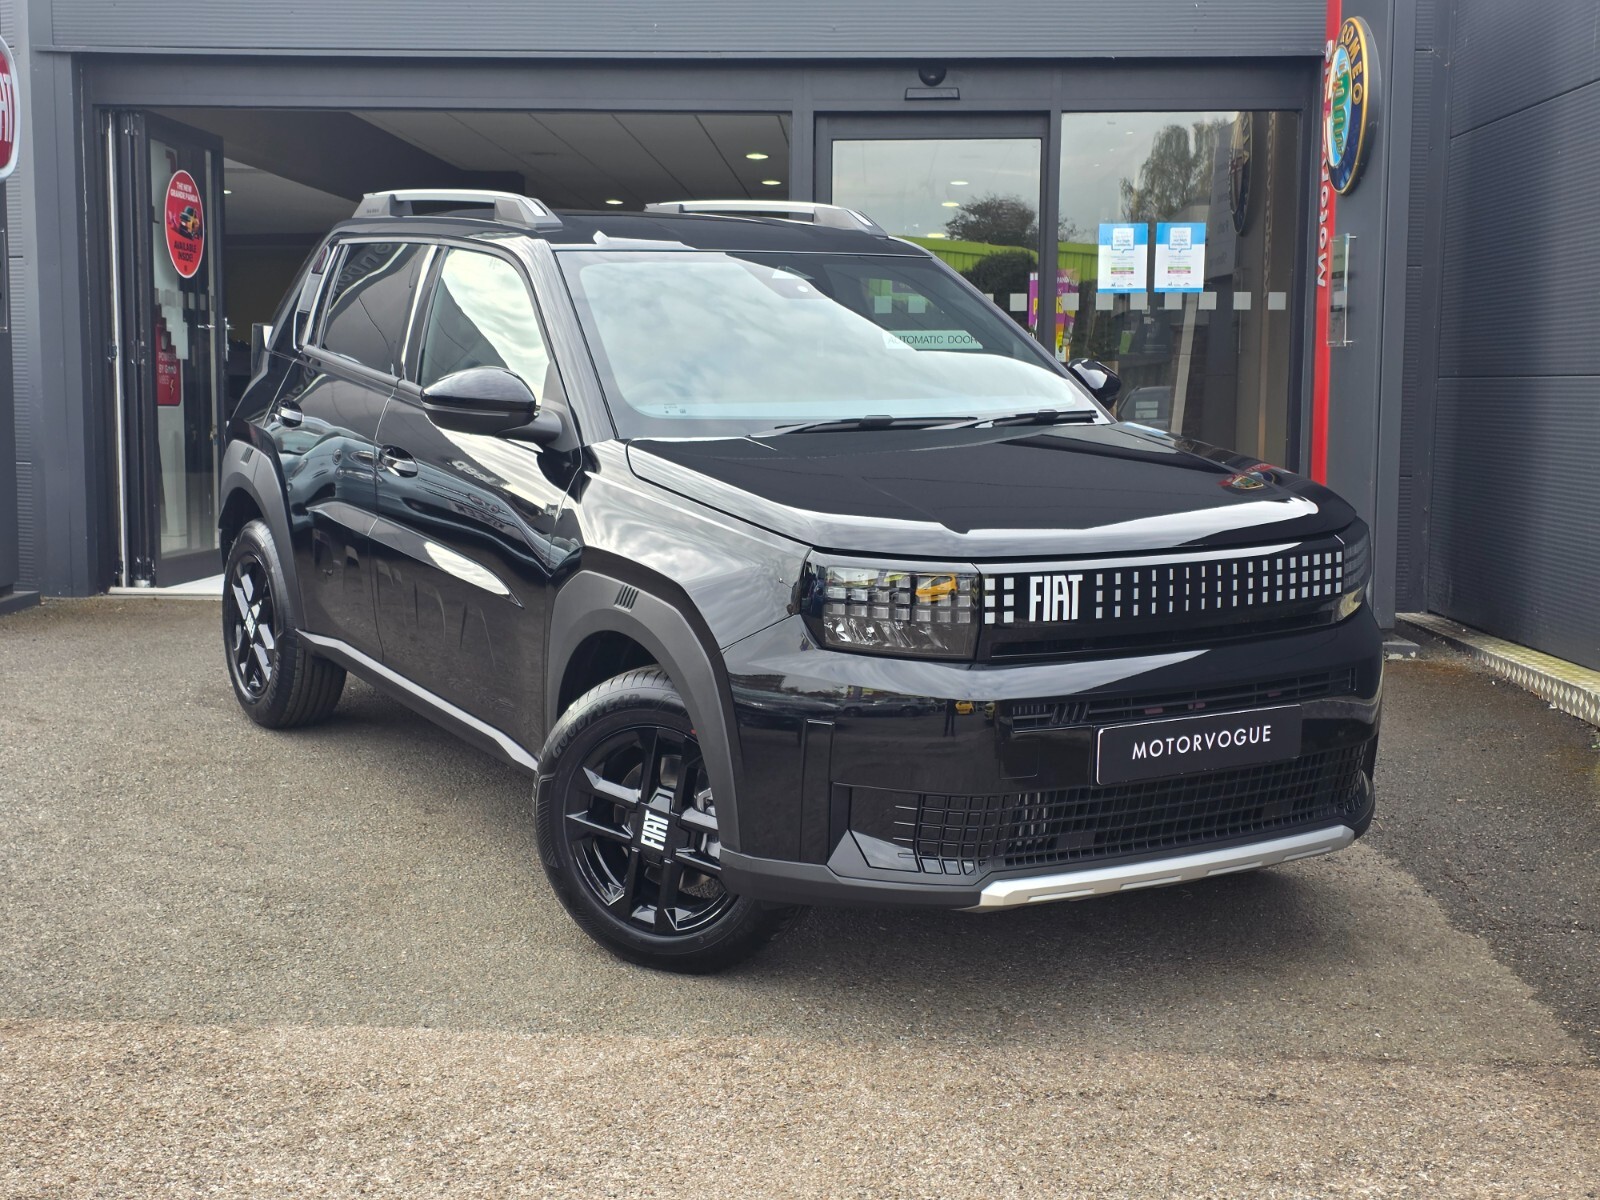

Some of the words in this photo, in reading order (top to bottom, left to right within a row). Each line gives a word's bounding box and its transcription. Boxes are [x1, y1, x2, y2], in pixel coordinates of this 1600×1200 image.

[1341, 24, 1363, 105] ROMEO
[888, 335, 943, 345] AUTOMATIC
[1028, 574, 1083, 622] FIAT
[552, 693, 641, 759] GOODYEAR
[1132, 725, 1272, 760] MOTORVOGUE
[640, 809, 670, 851] FIAT
